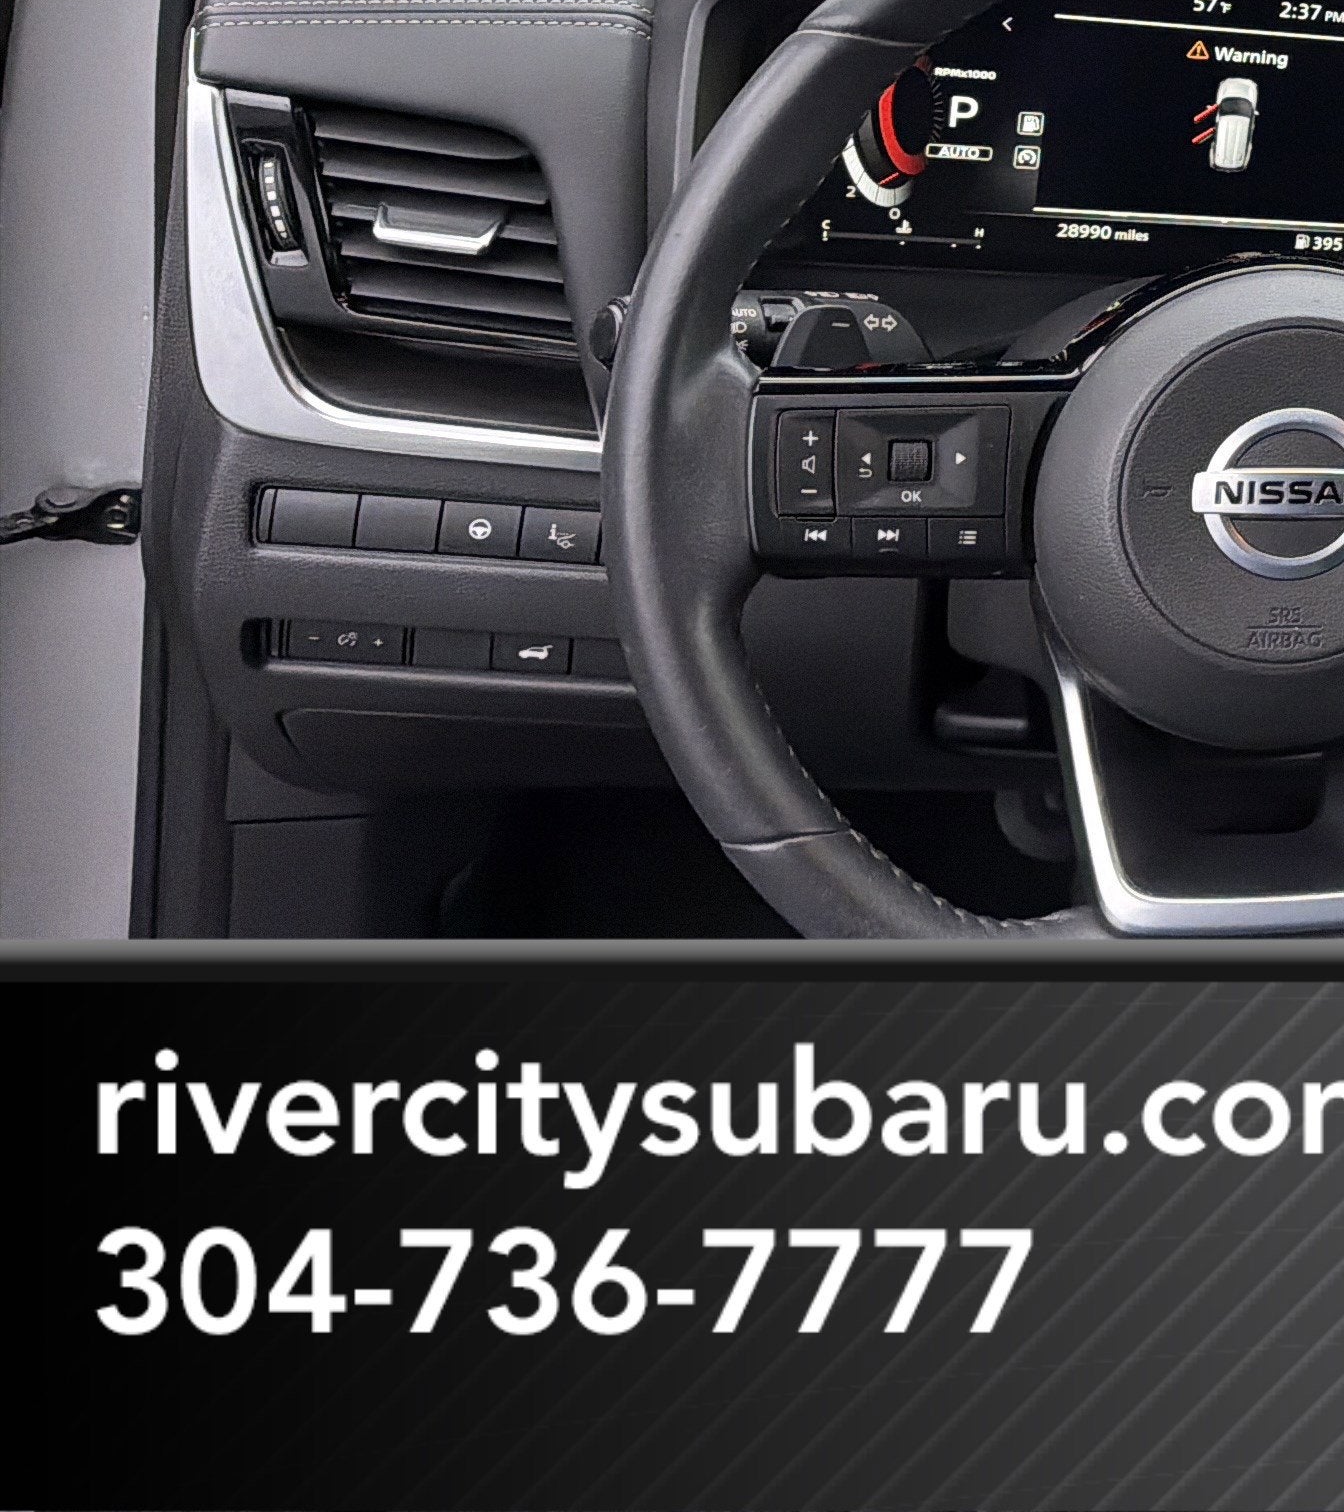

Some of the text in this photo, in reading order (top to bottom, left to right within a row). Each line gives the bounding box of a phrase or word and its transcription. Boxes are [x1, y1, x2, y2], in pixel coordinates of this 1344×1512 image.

[1279, 1, 1323, 21] 2:37
[1214, 46, 1289, 69] Warning
[933, 67, 997, 81] RPMx1000
[948, 95, 979, 128] P
[938, 146, 980, 159] AUTO
[846, 186, 856, 198] 2
[821, 219, 831, 230] C
[974, 227, 985, 238] H
[1056, 223, 1149, 242] 28990 miles
[1312, 236, 1343, 252] 395
[901, 490, 922, 503] OK
[1267, 607, 1302, 624] SRS
[1248, 629, 1324, 650] AIRBAG
